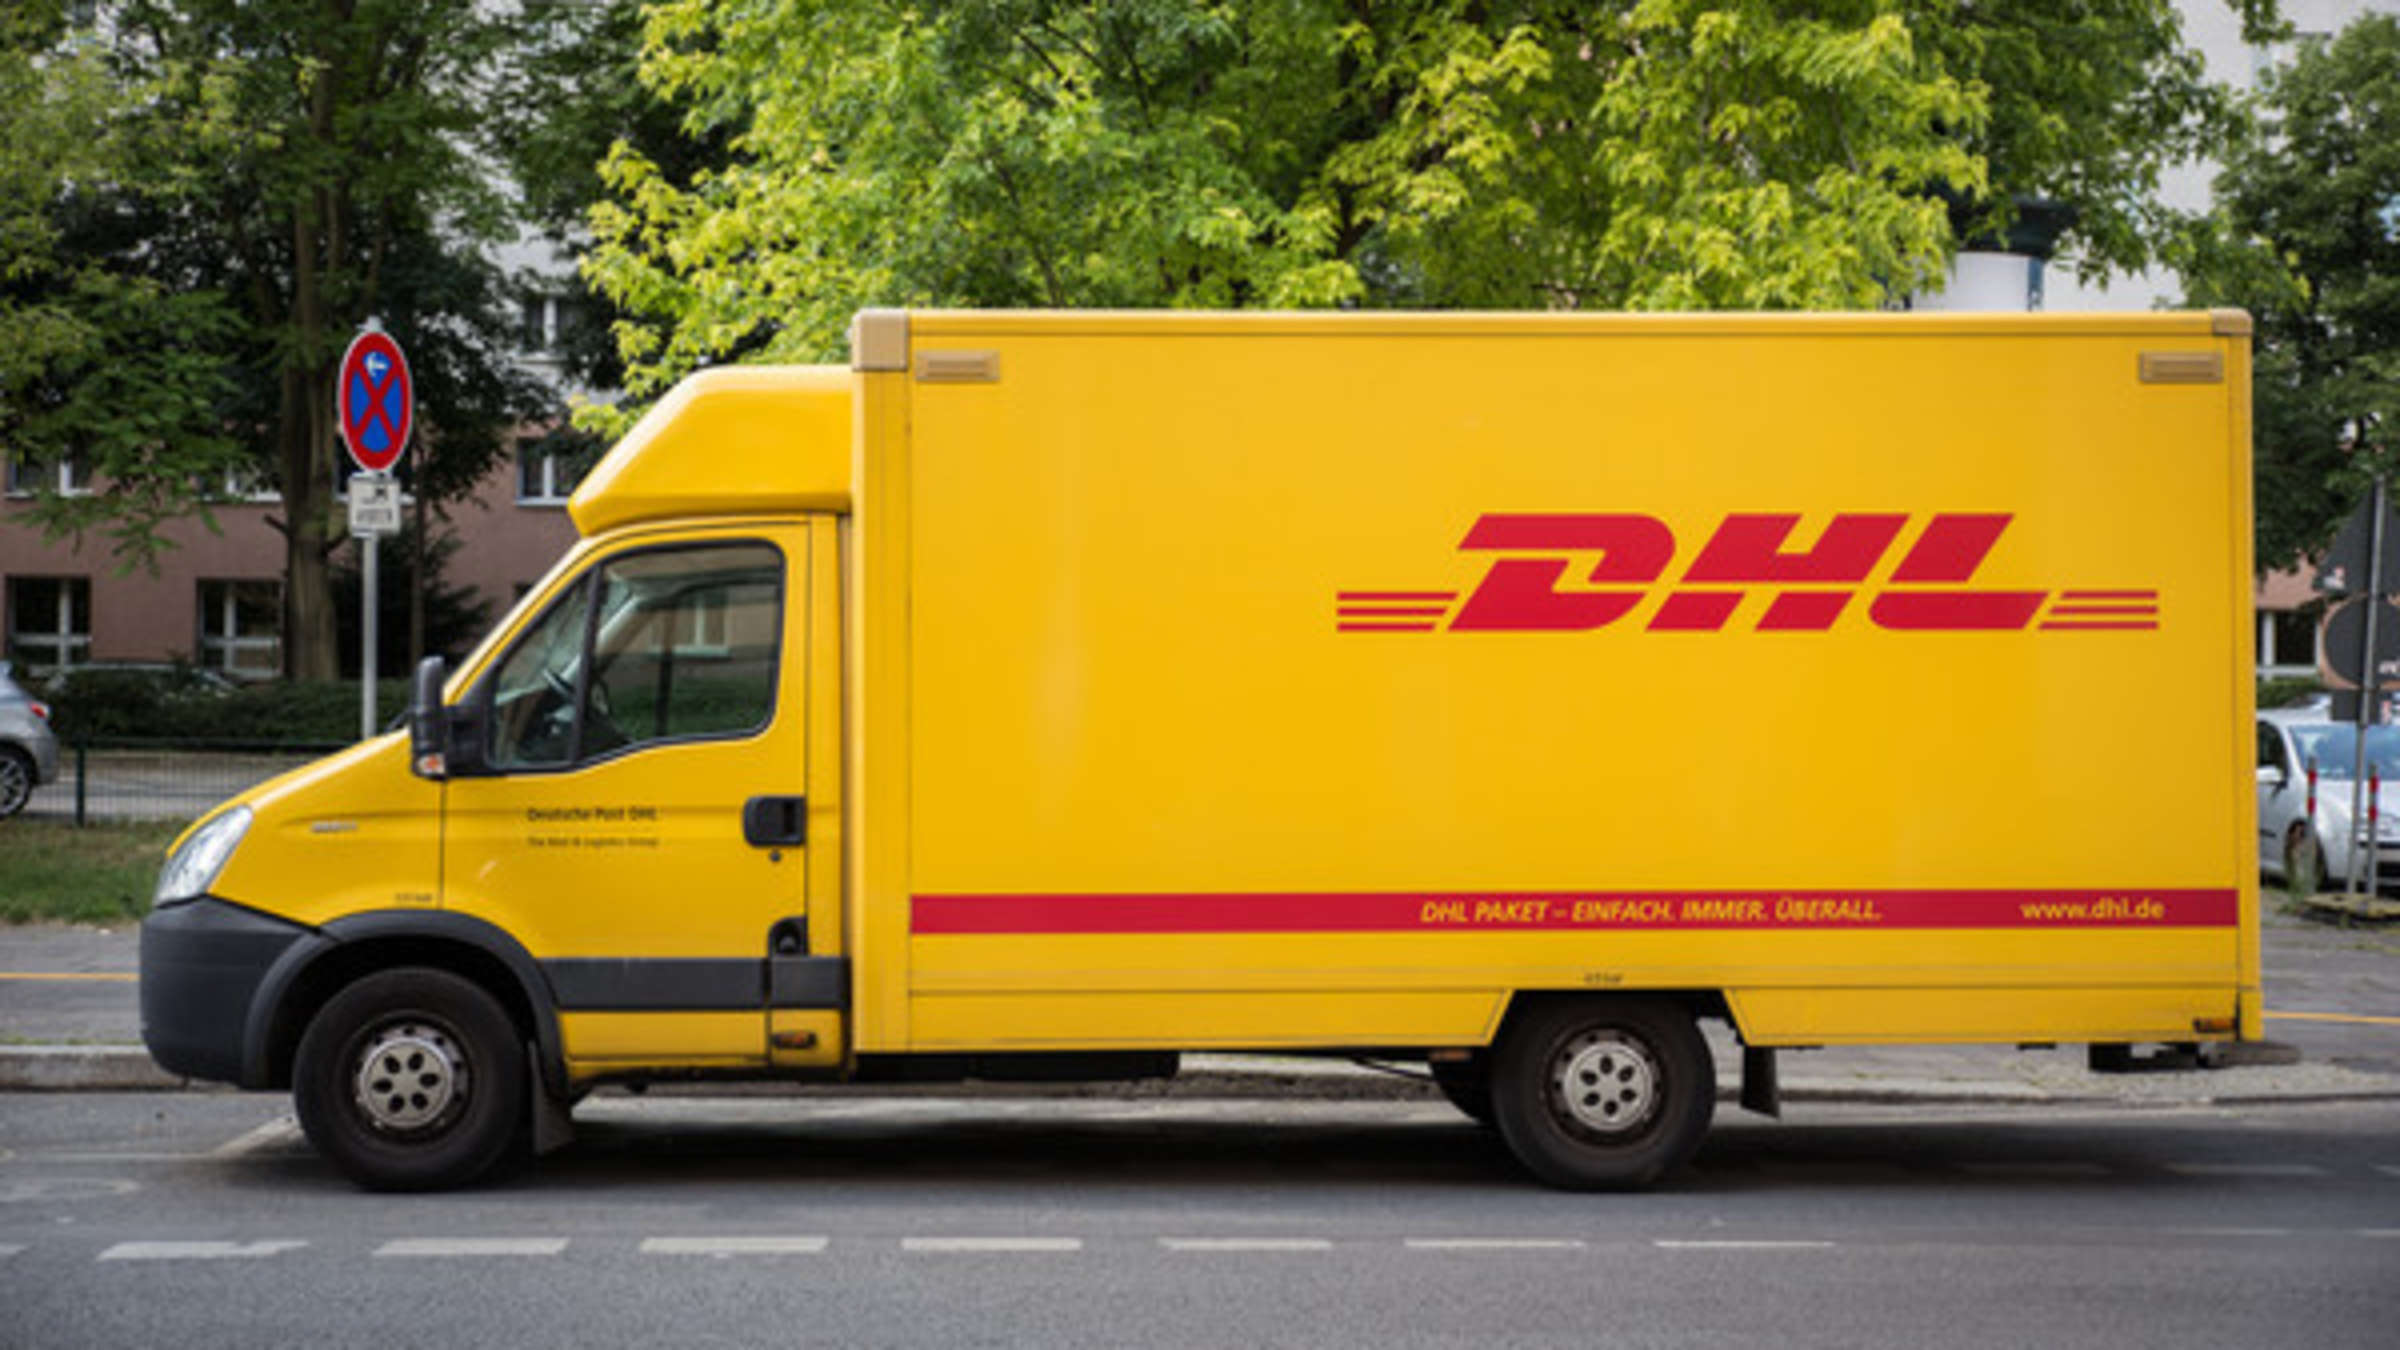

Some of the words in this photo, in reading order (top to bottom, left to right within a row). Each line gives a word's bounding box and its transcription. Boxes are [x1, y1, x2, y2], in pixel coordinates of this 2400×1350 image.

[1446, 512, 2051, 632] DHL
[527, 806, 590, 822] Deutsche
[594, 806, 625, 821] Post
[628, 805, 657, 822] DHL
[1420, 900, 1467, 923] DHL
[1474, 900, 1549, 923] PAKET
[1572, 900, 1676, 923] EINFACH.
[1680, 900, 1768, 922] IMMER.
[1774, 895, 1883, 922] ÜBERALL.
[2019, 897, 2166, 920] www.dhl.de
